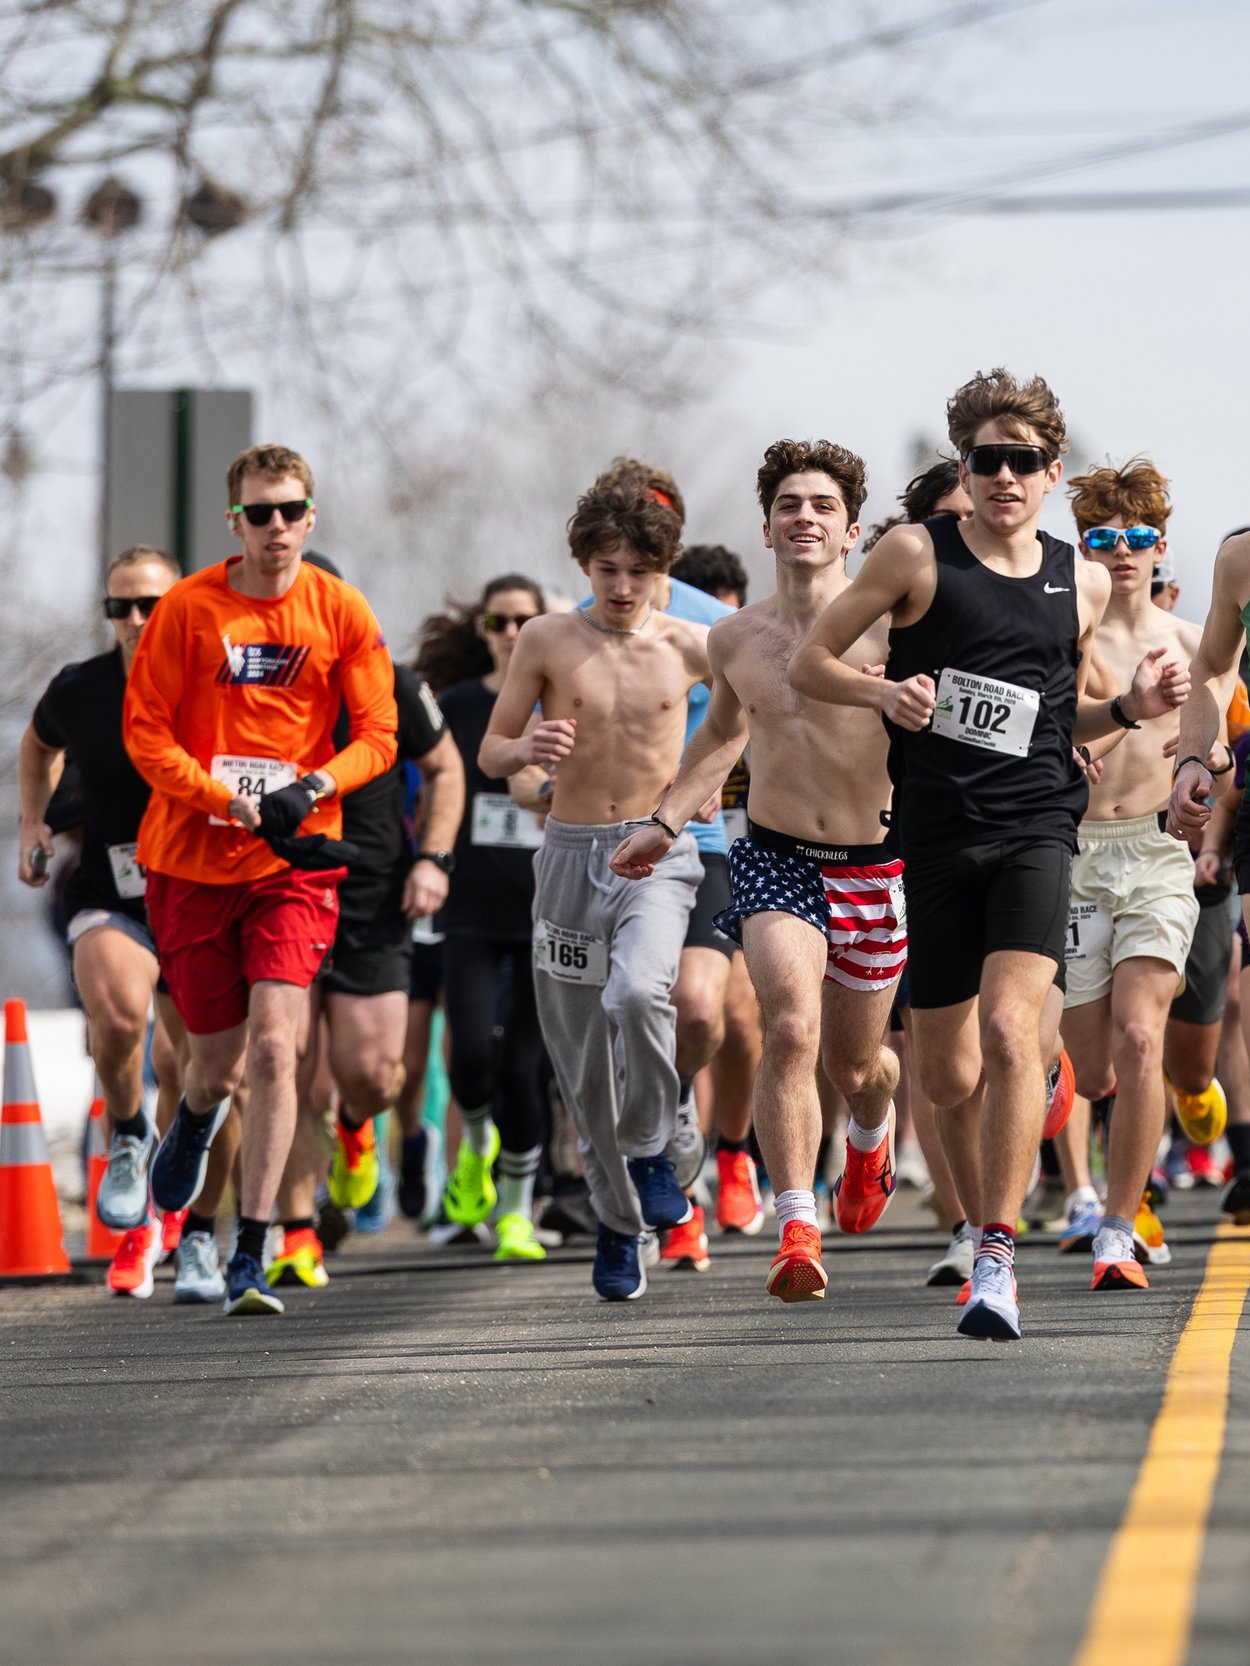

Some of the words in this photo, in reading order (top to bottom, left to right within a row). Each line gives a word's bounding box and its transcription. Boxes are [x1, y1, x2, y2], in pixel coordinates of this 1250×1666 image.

[952, 675, 982, 690] BOLTON
[984, 683, 1005, 696] ROAD
[959, 696, 1011, 734] 102
[965, 727, 992, 739] DOMINIC
[238, 777, 266, 797] 84
[805, 847, 848, 860] CHICKNLEGS
[1080, 904, 1098, 913] RACE
[561, 930, 578, 940] ROAD
[580, 933, 596, 943] RACE
[548, 940, 588, 970] 165
